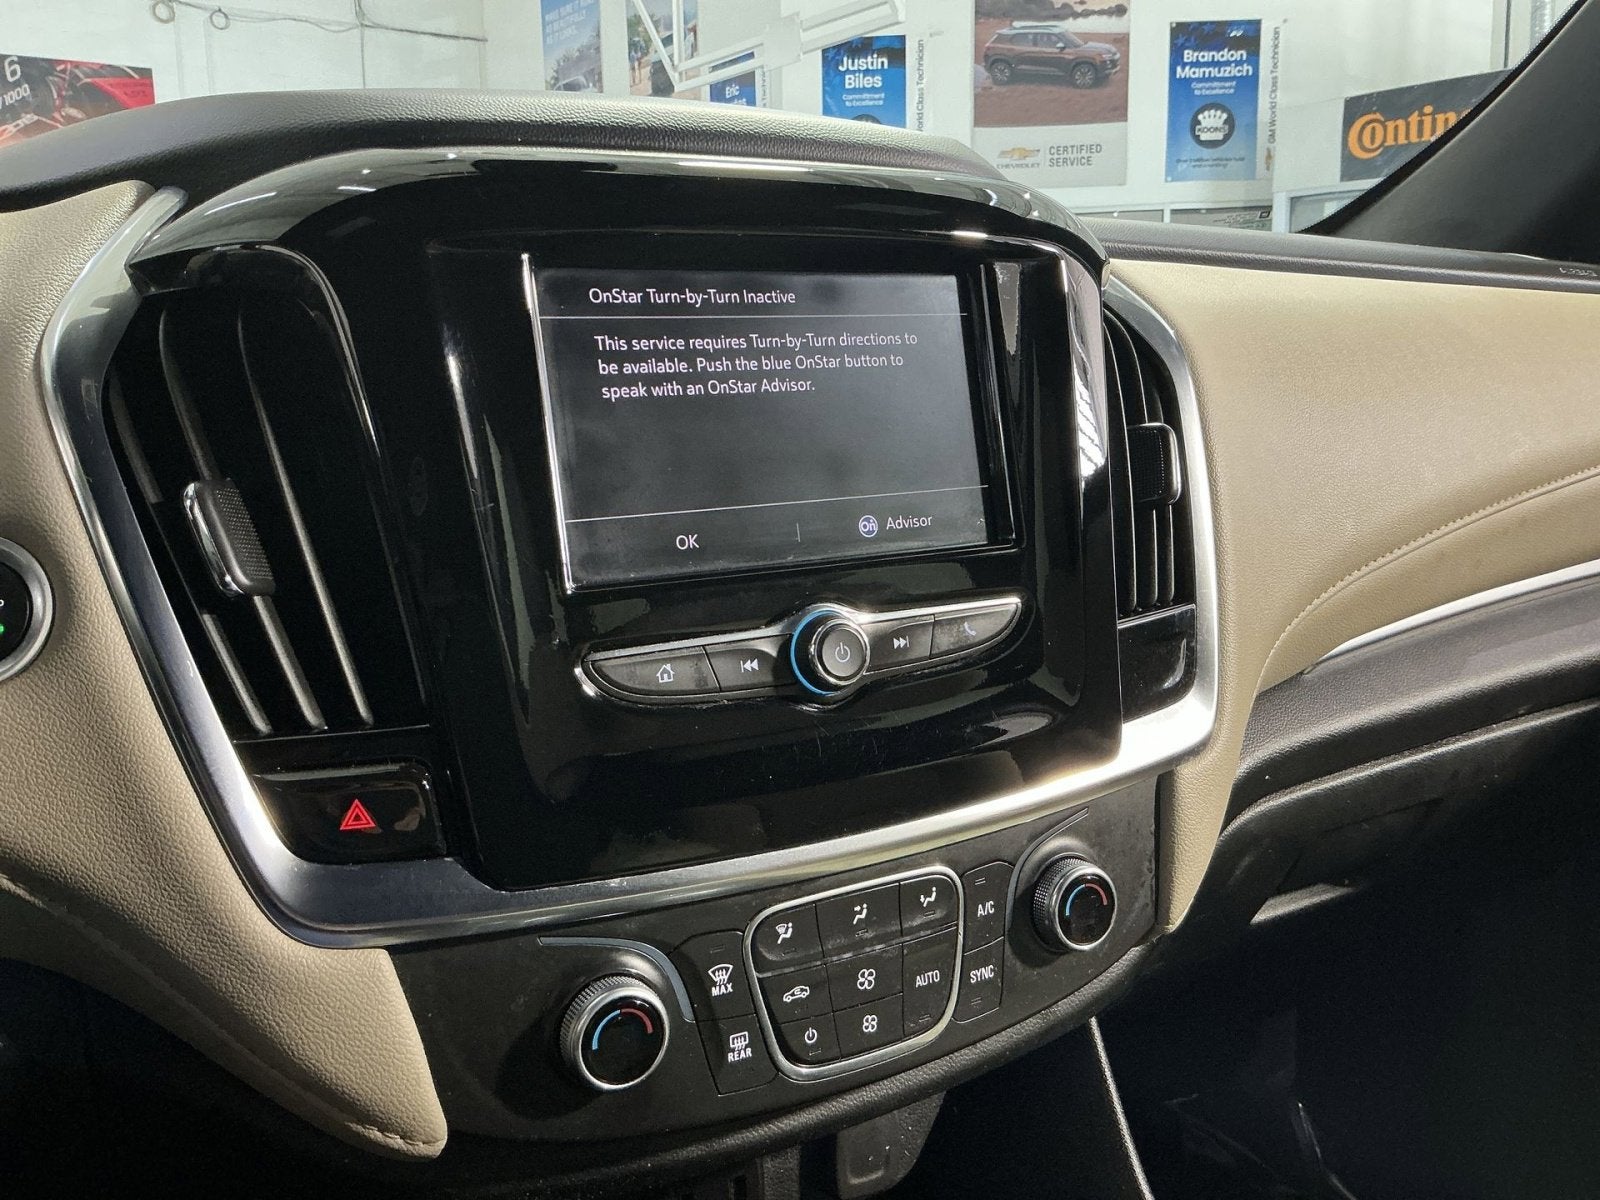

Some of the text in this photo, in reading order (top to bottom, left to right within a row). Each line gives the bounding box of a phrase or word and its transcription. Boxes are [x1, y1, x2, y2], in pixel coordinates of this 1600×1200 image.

[838, 53, 888, 71] Justin
[915, 40, 924, 86] Technician
[1183, 49, 1246, 62] Brandon
[1176, 64, 1253, 78] Mamuzich
[845, 73, 882, 88] Biles
[1268, 26, 1280, 144] GM World Class Technician
[726, 84, 740, 98] Eric
[1348, 104, 1472, 160] Contin
[1048, 144, 1102, 156] CERTIFIED
[1048, 156, 1093, 168] SERVICE
[589, 288, 796, 308] OnStar Turn-by-Turn Inactive
[594, 332, 918, 352] This service requires Turn-by-Turn directions to
[598, 354, 904, 374] be available. Push the blue OnStar button to
[602, 378, 816, 402] speak with an OnStar Advisor.
[886, 515, 932, 530] Advisor
[676, 534, 699, 550] OK
[977, 901, 995, 917] A/C
[916, 970, 940, 988] AUTO
[970, 965, 994, 984] SYNC
[712, 982, 733, 997] MAX
[728, 1048, 752, 1063] REAR
